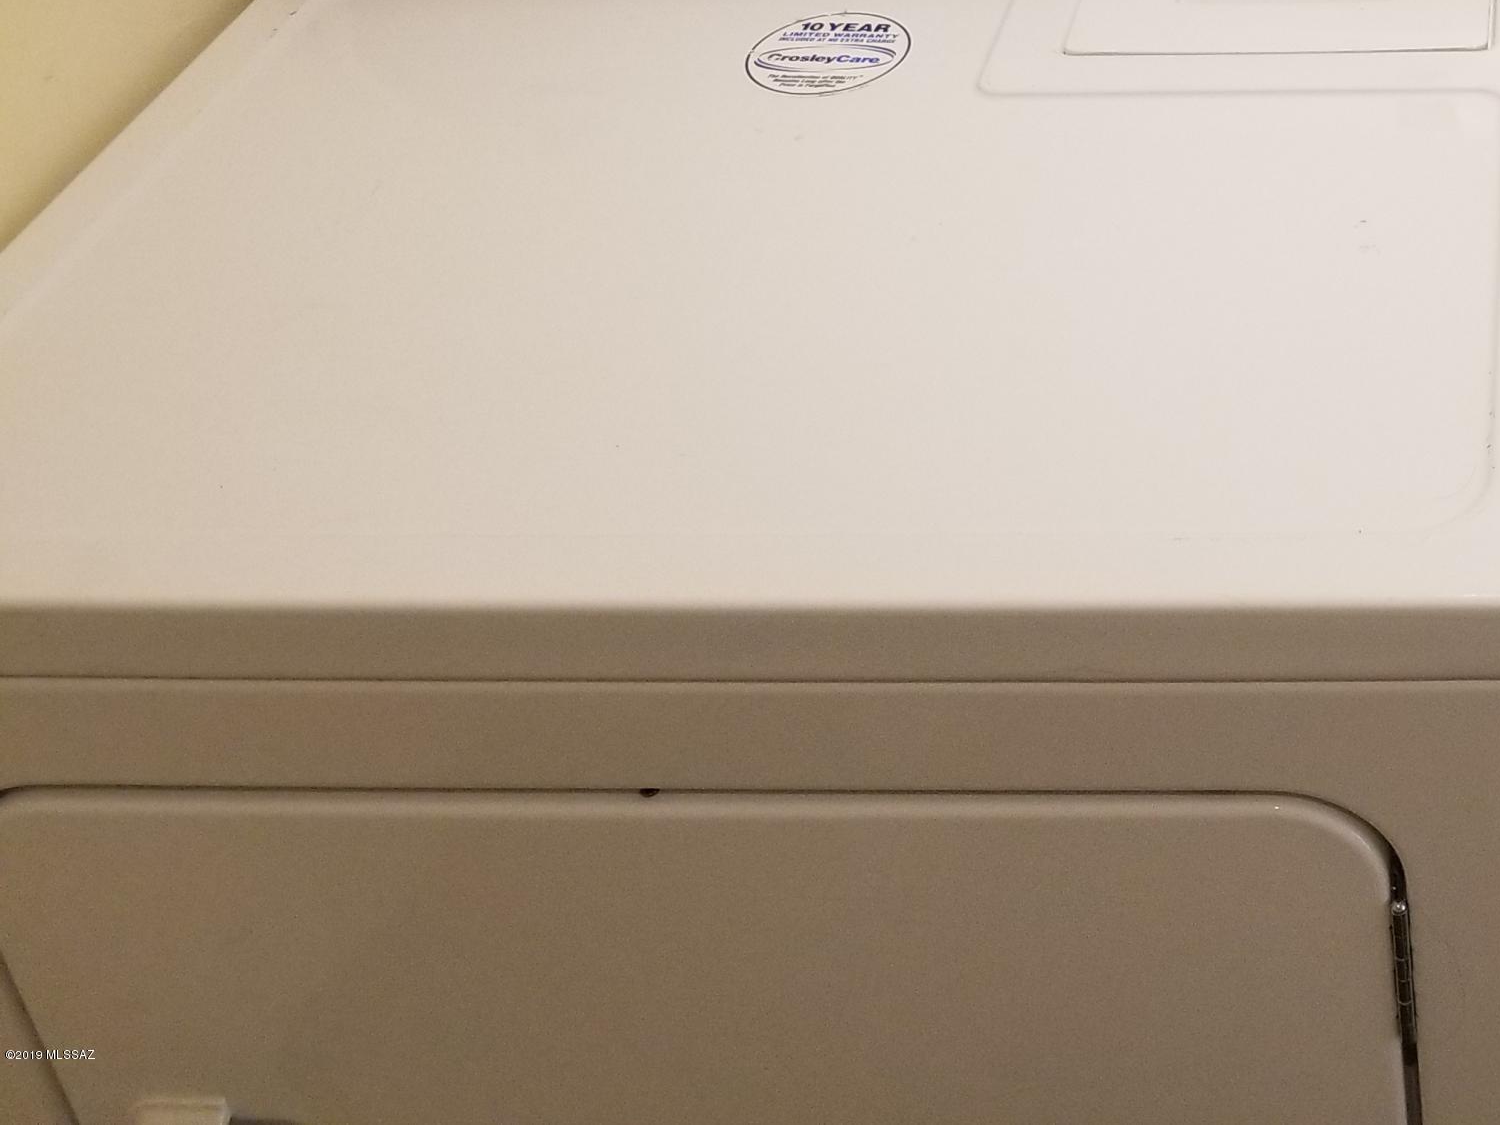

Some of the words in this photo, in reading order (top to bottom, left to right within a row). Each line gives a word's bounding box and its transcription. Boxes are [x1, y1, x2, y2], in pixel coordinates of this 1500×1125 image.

[802, 22, 824, 31] 10
[829, 23, 891, 32] YEAR
[768, 53, 880, 63] CrosleyCare
